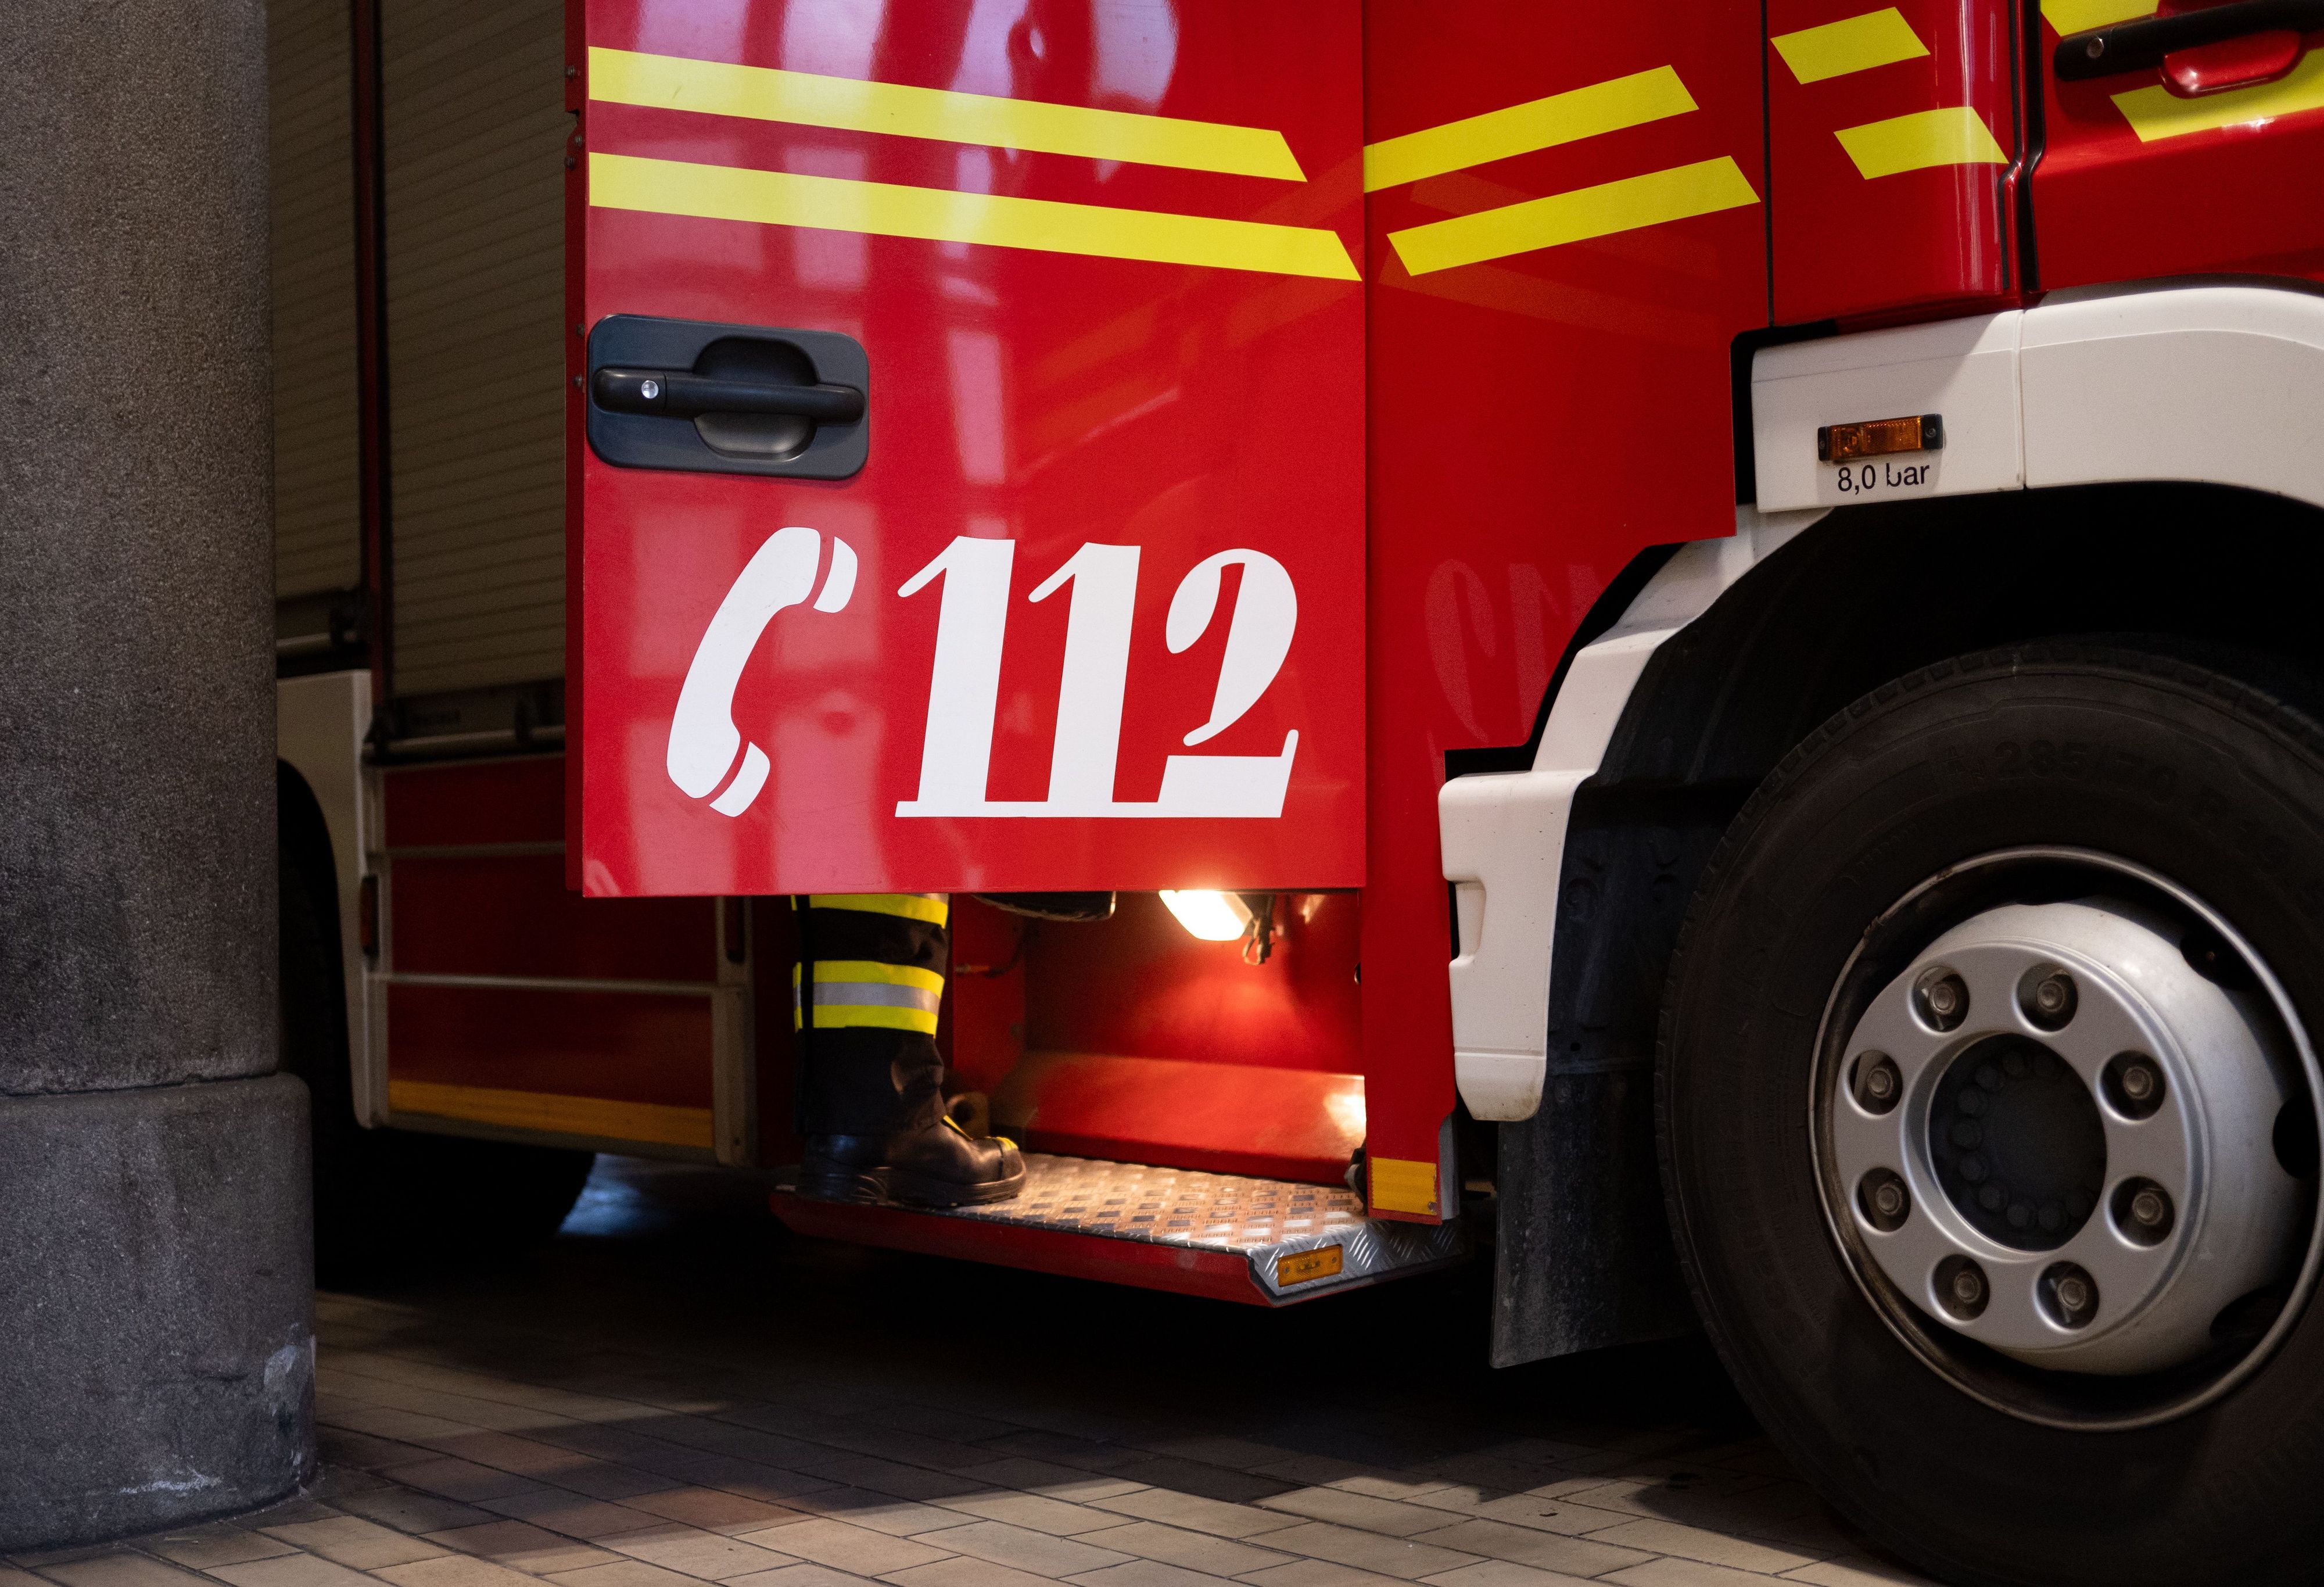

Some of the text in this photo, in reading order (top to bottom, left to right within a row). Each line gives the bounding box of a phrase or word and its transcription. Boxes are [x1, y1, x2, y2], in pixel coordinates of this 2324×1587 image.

[1838, 463, 1930, 495] 8,0 bar
[895, 536, 1299, 817] 112
